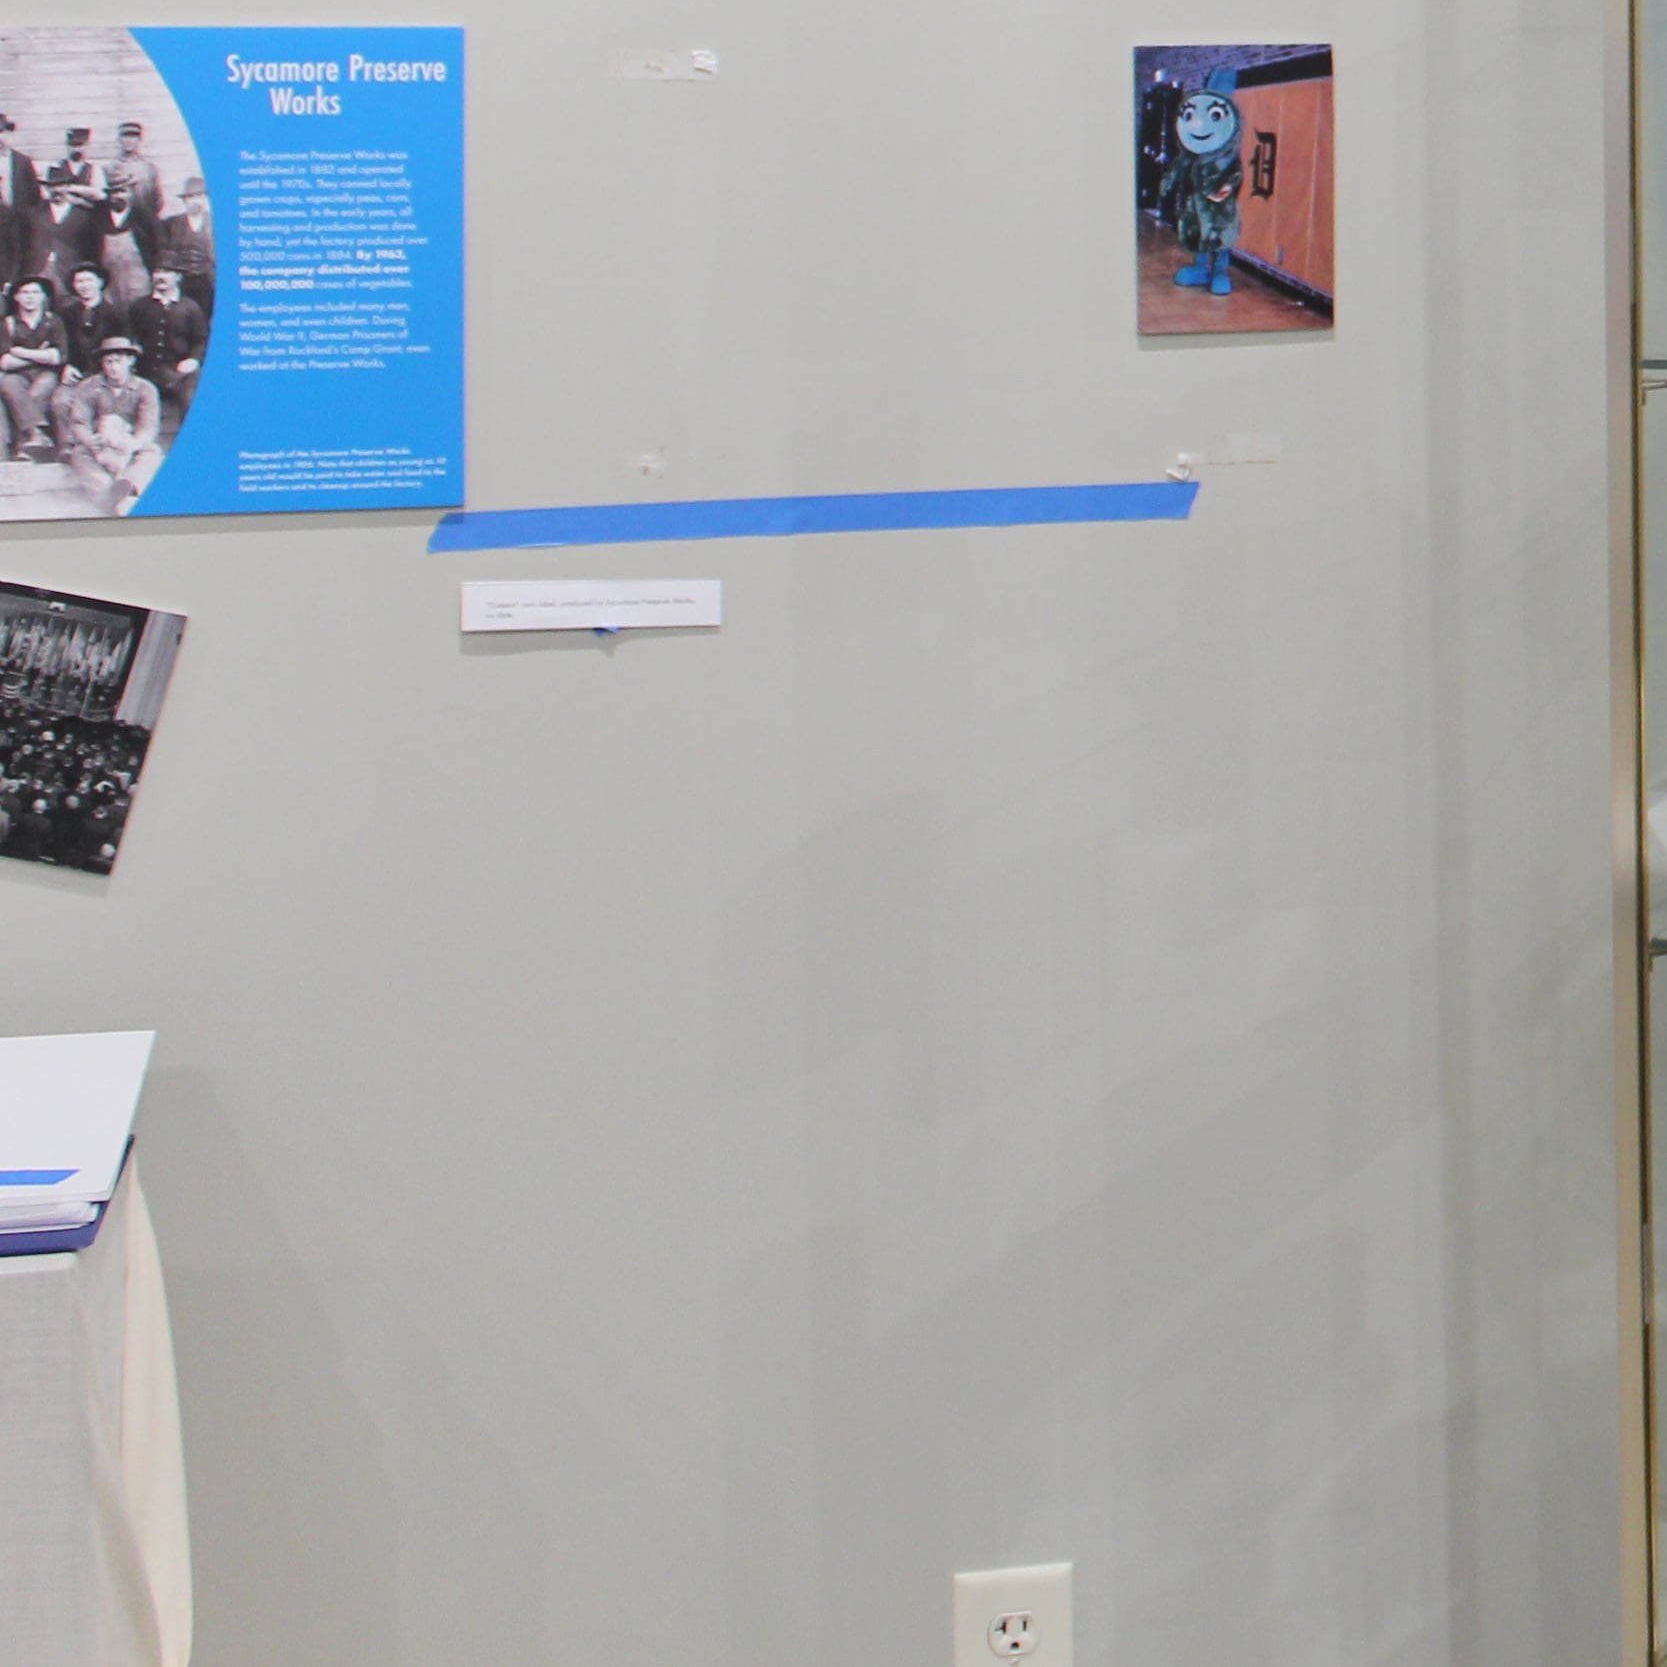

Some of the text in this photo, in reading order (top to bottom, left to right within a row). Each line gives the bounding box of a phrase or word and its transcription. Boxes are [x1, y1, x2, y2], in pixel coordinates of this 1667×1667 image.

[226, 54, 446, 89] Sycamore Preserve
[269, 86, 341, 115] Works
